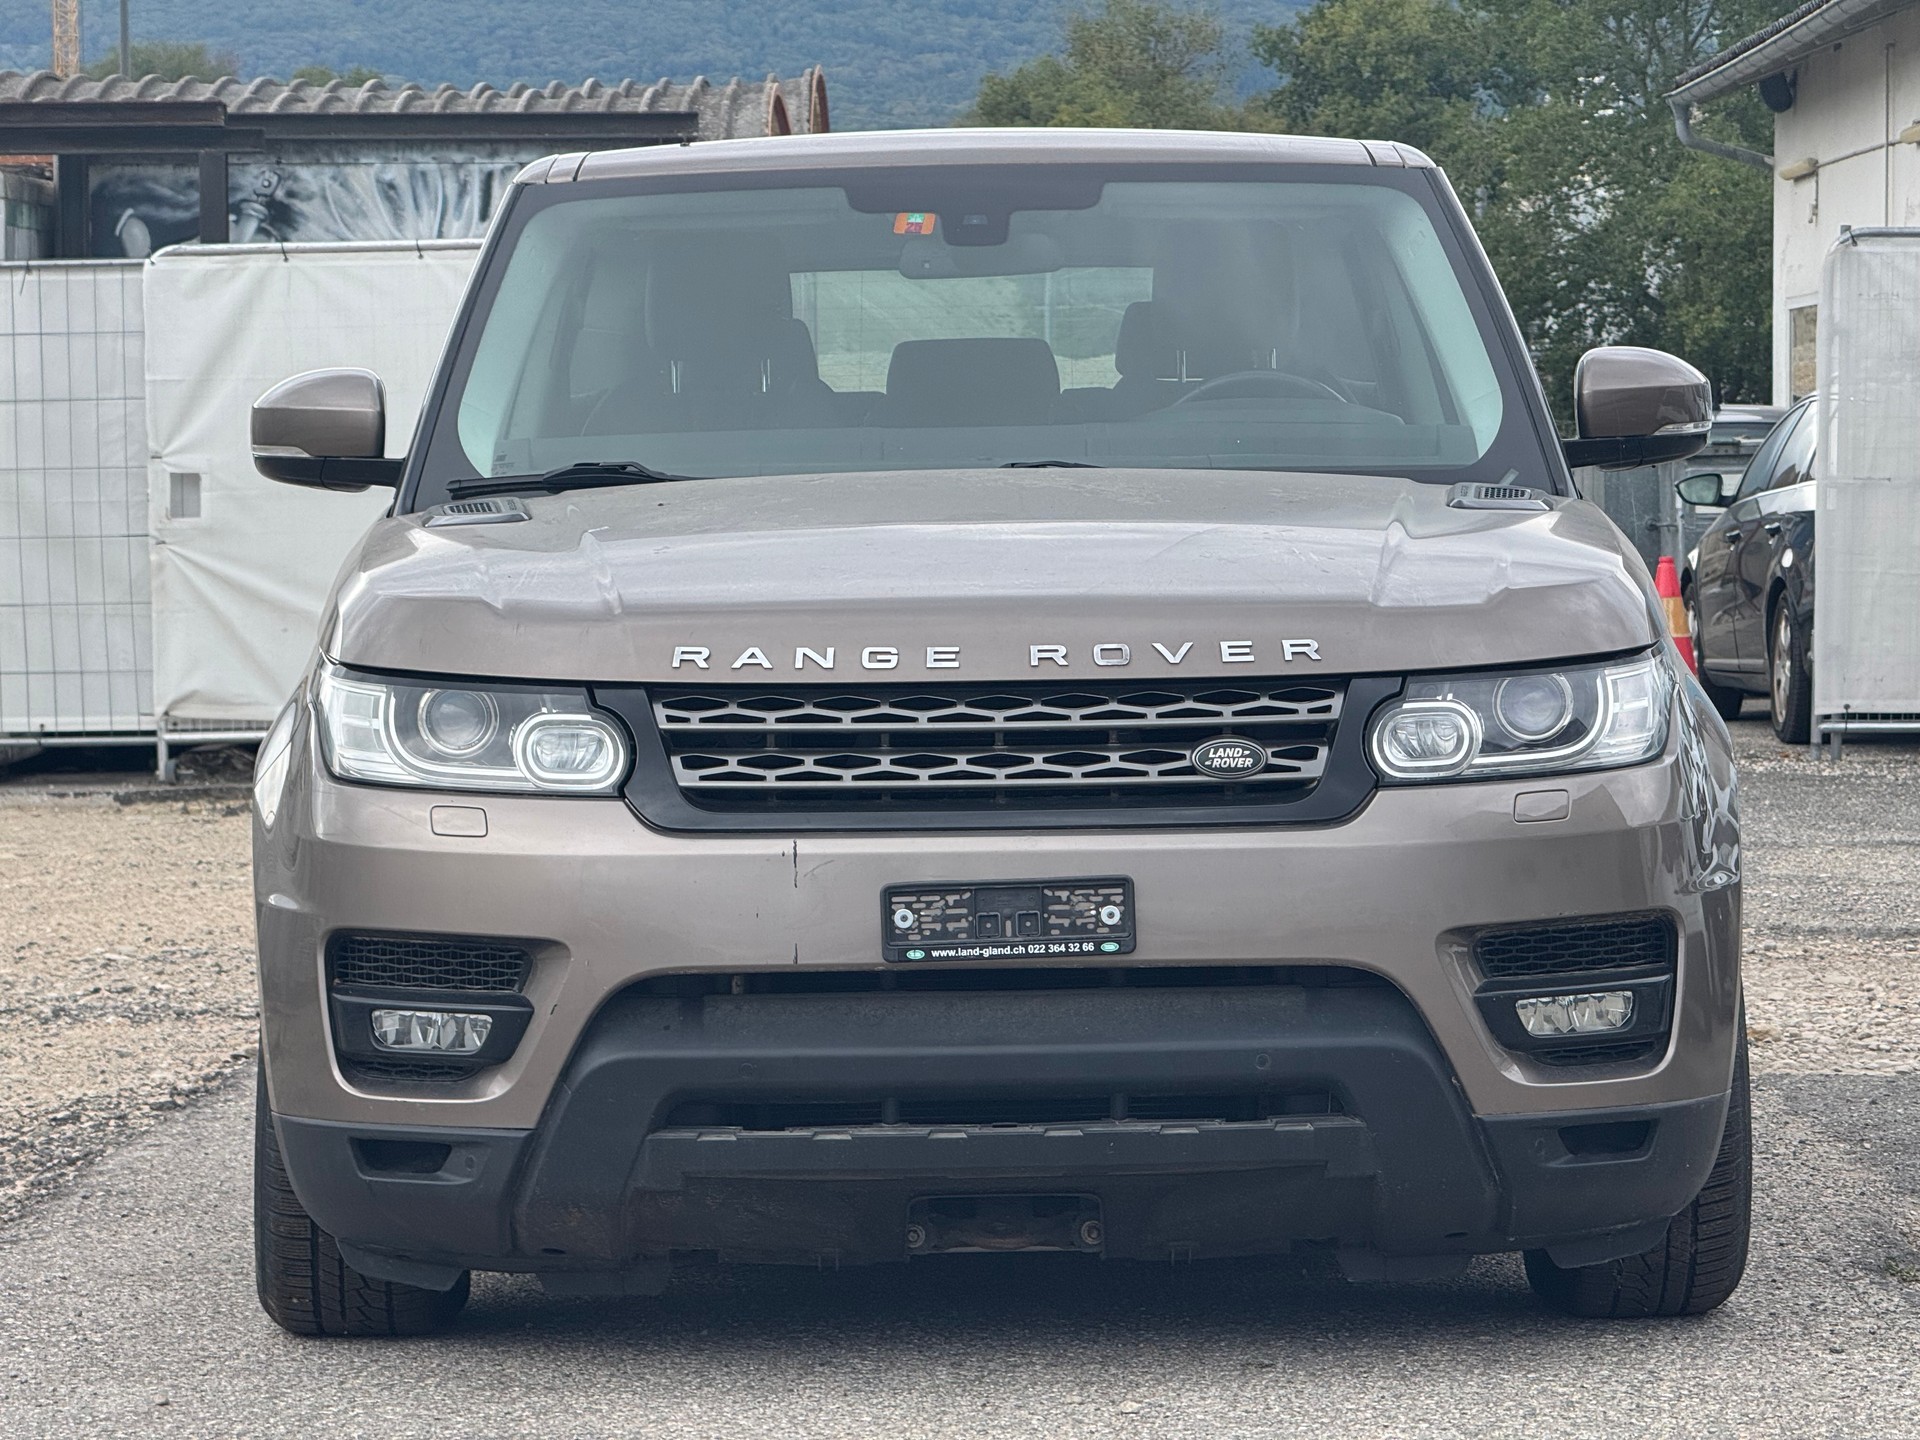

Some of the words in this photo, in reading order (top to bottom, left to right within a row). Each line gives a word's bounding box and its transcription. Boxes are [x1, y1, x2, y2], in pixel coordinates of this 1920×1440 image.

[672, 646, 960, 669] RANGE
[1029, 638, 1322, 666] ROVER
[1209, 748, 1242, 757] LAND
[1212, 758, 1253, 767] ROVER
[931, 945, 1025, 957] www.land-gland.ch
[1027, 944, 1046, 953] 022
[1048, 943, 1066, 952] 364
[1068, 942, 1080, 951] 32
[1082, 942, 1095, 951] 66
